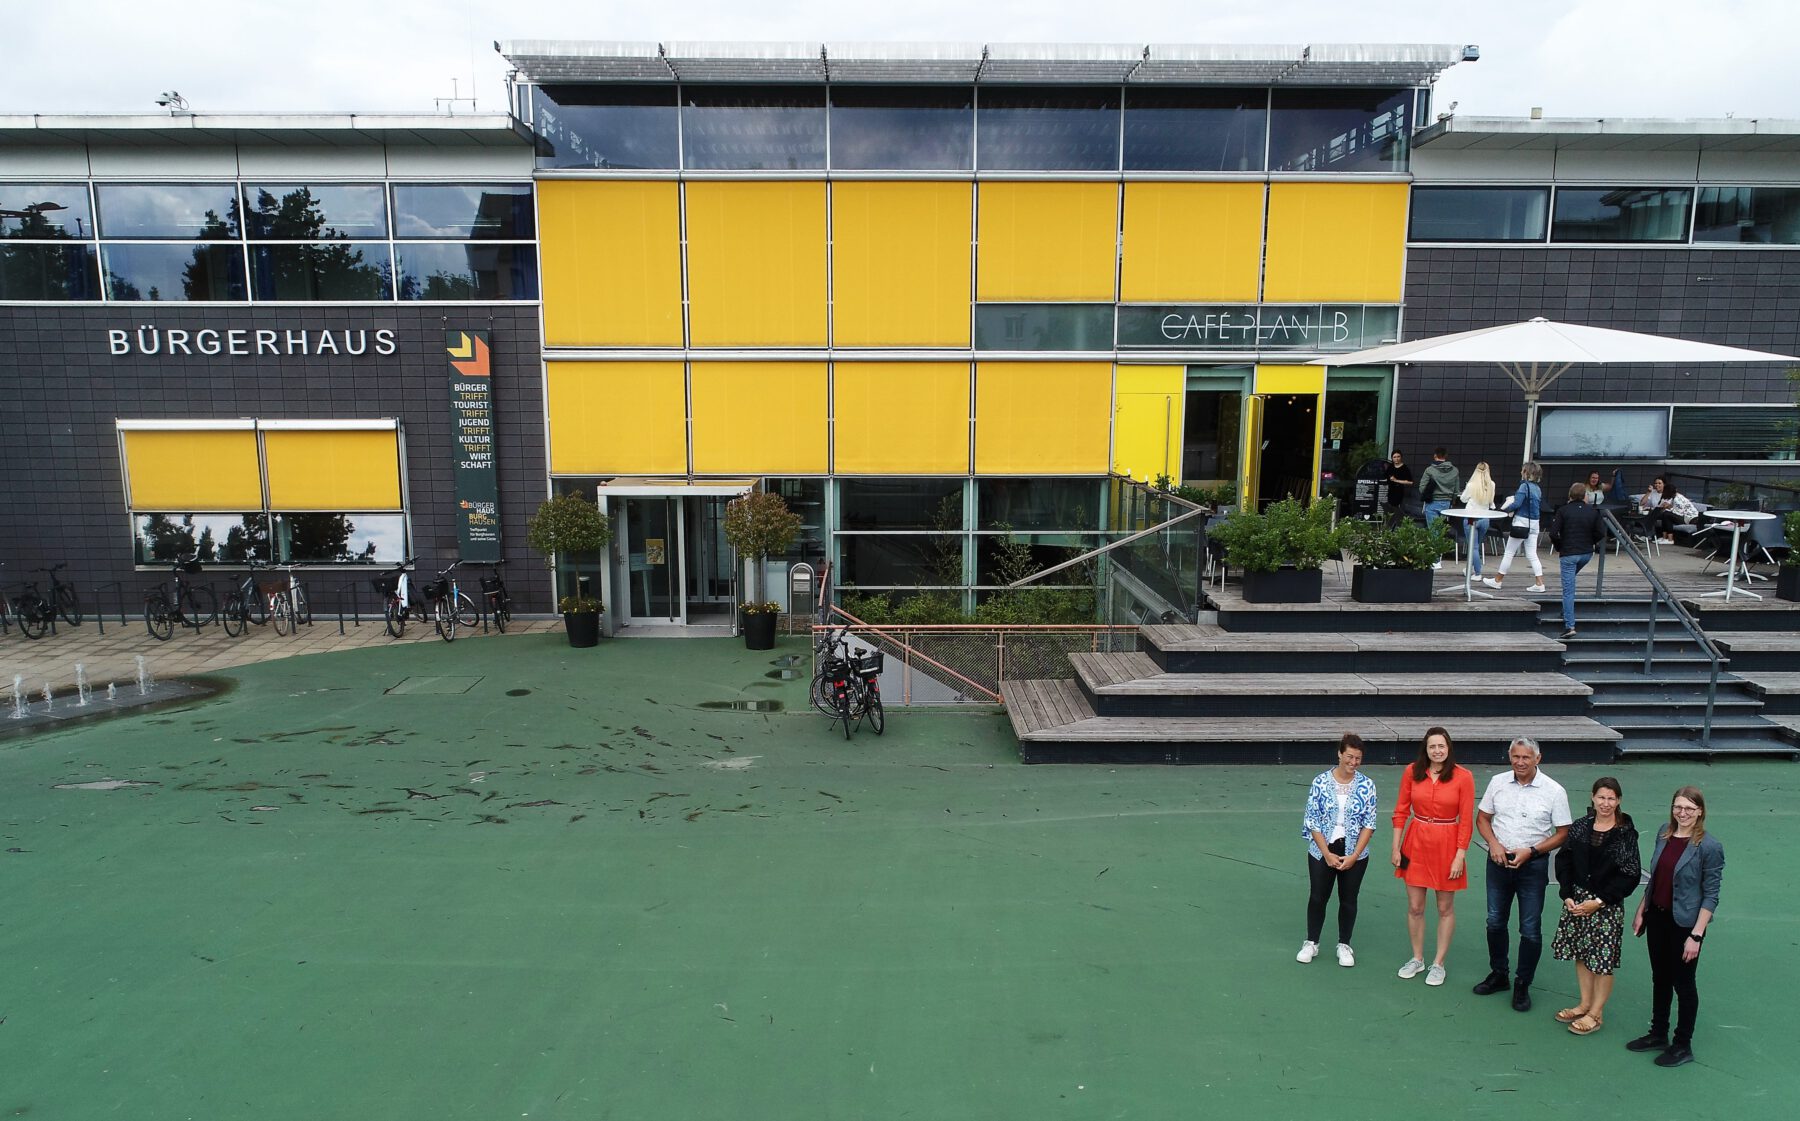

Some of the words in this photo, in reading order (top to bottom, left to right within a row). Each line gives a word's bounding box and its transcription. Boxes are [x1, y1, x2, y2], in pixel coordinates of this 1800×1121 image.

[1161, 312, 1231, 340] CAFÉ
[1243, 314, 1309, 340] PLAN
[1333, 311, 1349, 342] B
[108, 324, 397, 355] BÜRGERHAUS
[454, 382, 488, 391] BÜRGER
[460, 392, 488, 400] TRIFFT
[459, 418, 490, 427] JUGEND
[462, 427, 490, 435] TRIFFT
[459, 435, 491, 443] KULTUR
[463, 444, 491, 452] TRIFFT
[469, 453, 492, 461] WIRT
